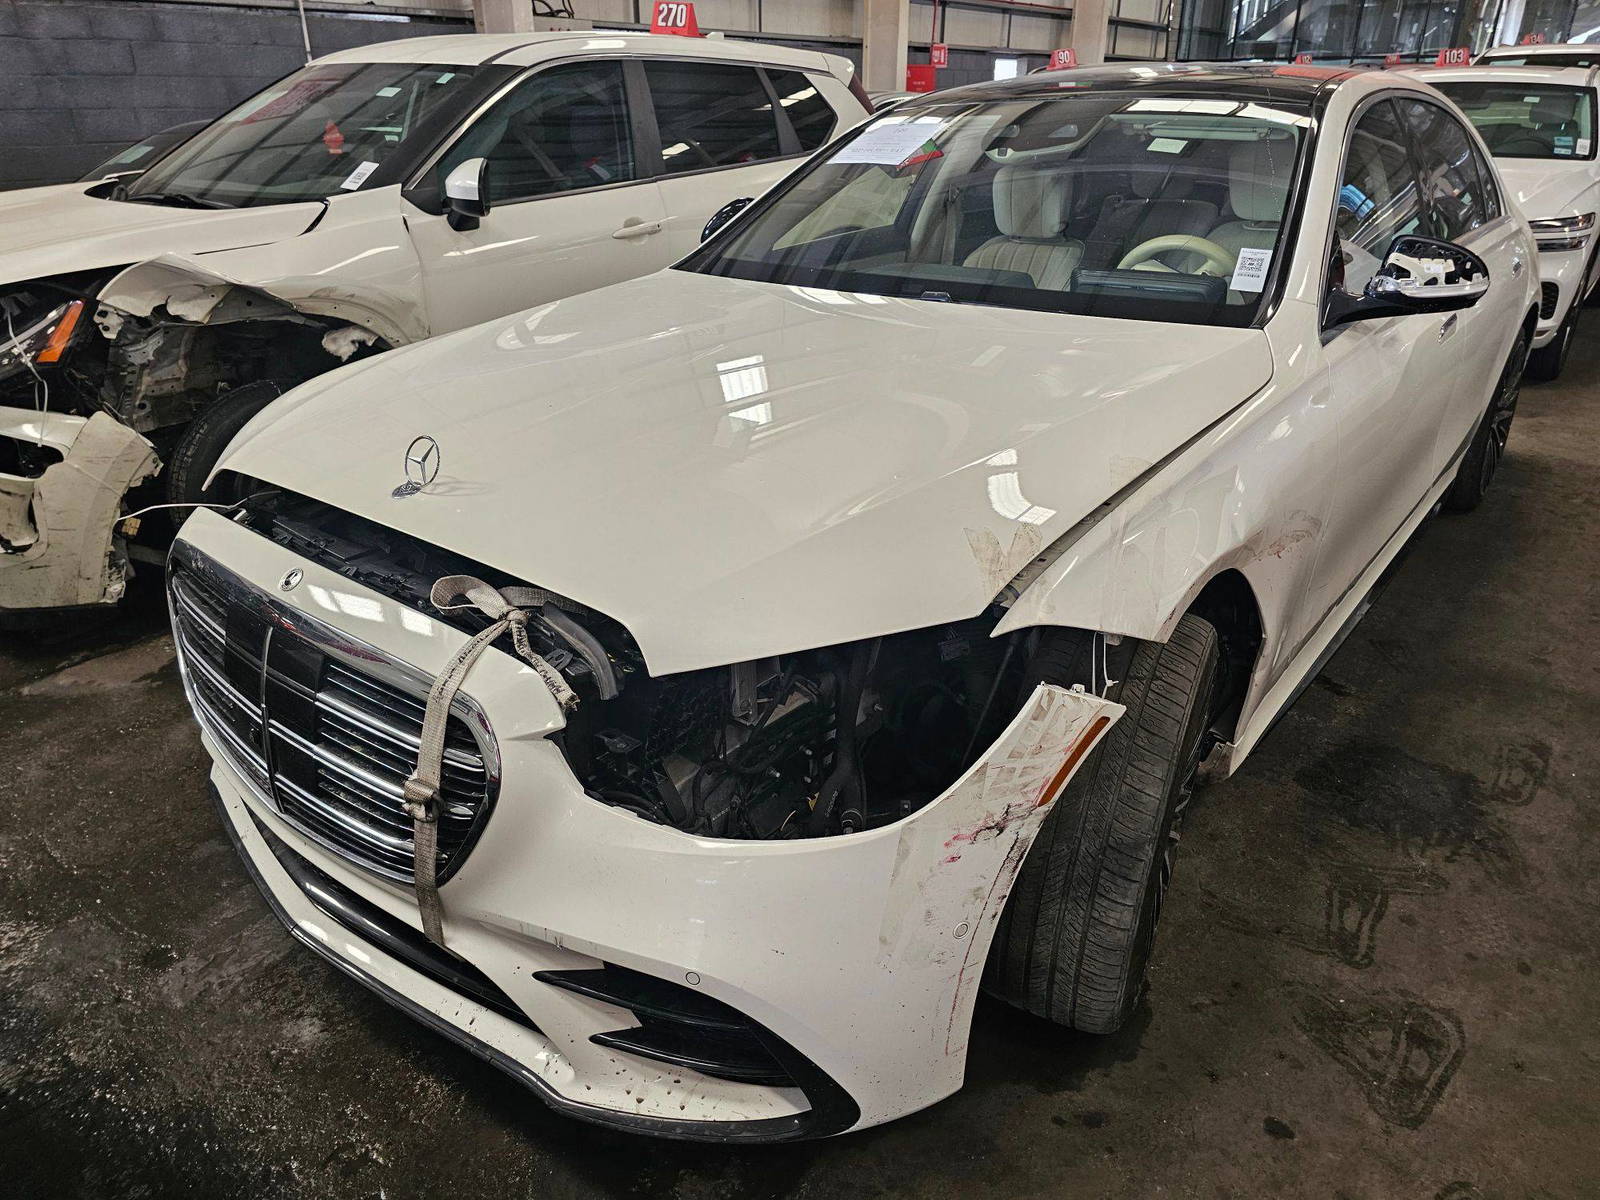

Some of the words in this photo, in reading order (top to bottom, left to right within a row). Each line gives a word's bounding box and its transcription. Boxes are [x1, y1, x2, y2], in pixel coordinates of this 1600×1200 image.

[657, 3, 687, 27] 270
[1058, 50, 1070, 64] 90
[1445, 48, 1464, 64] 103
